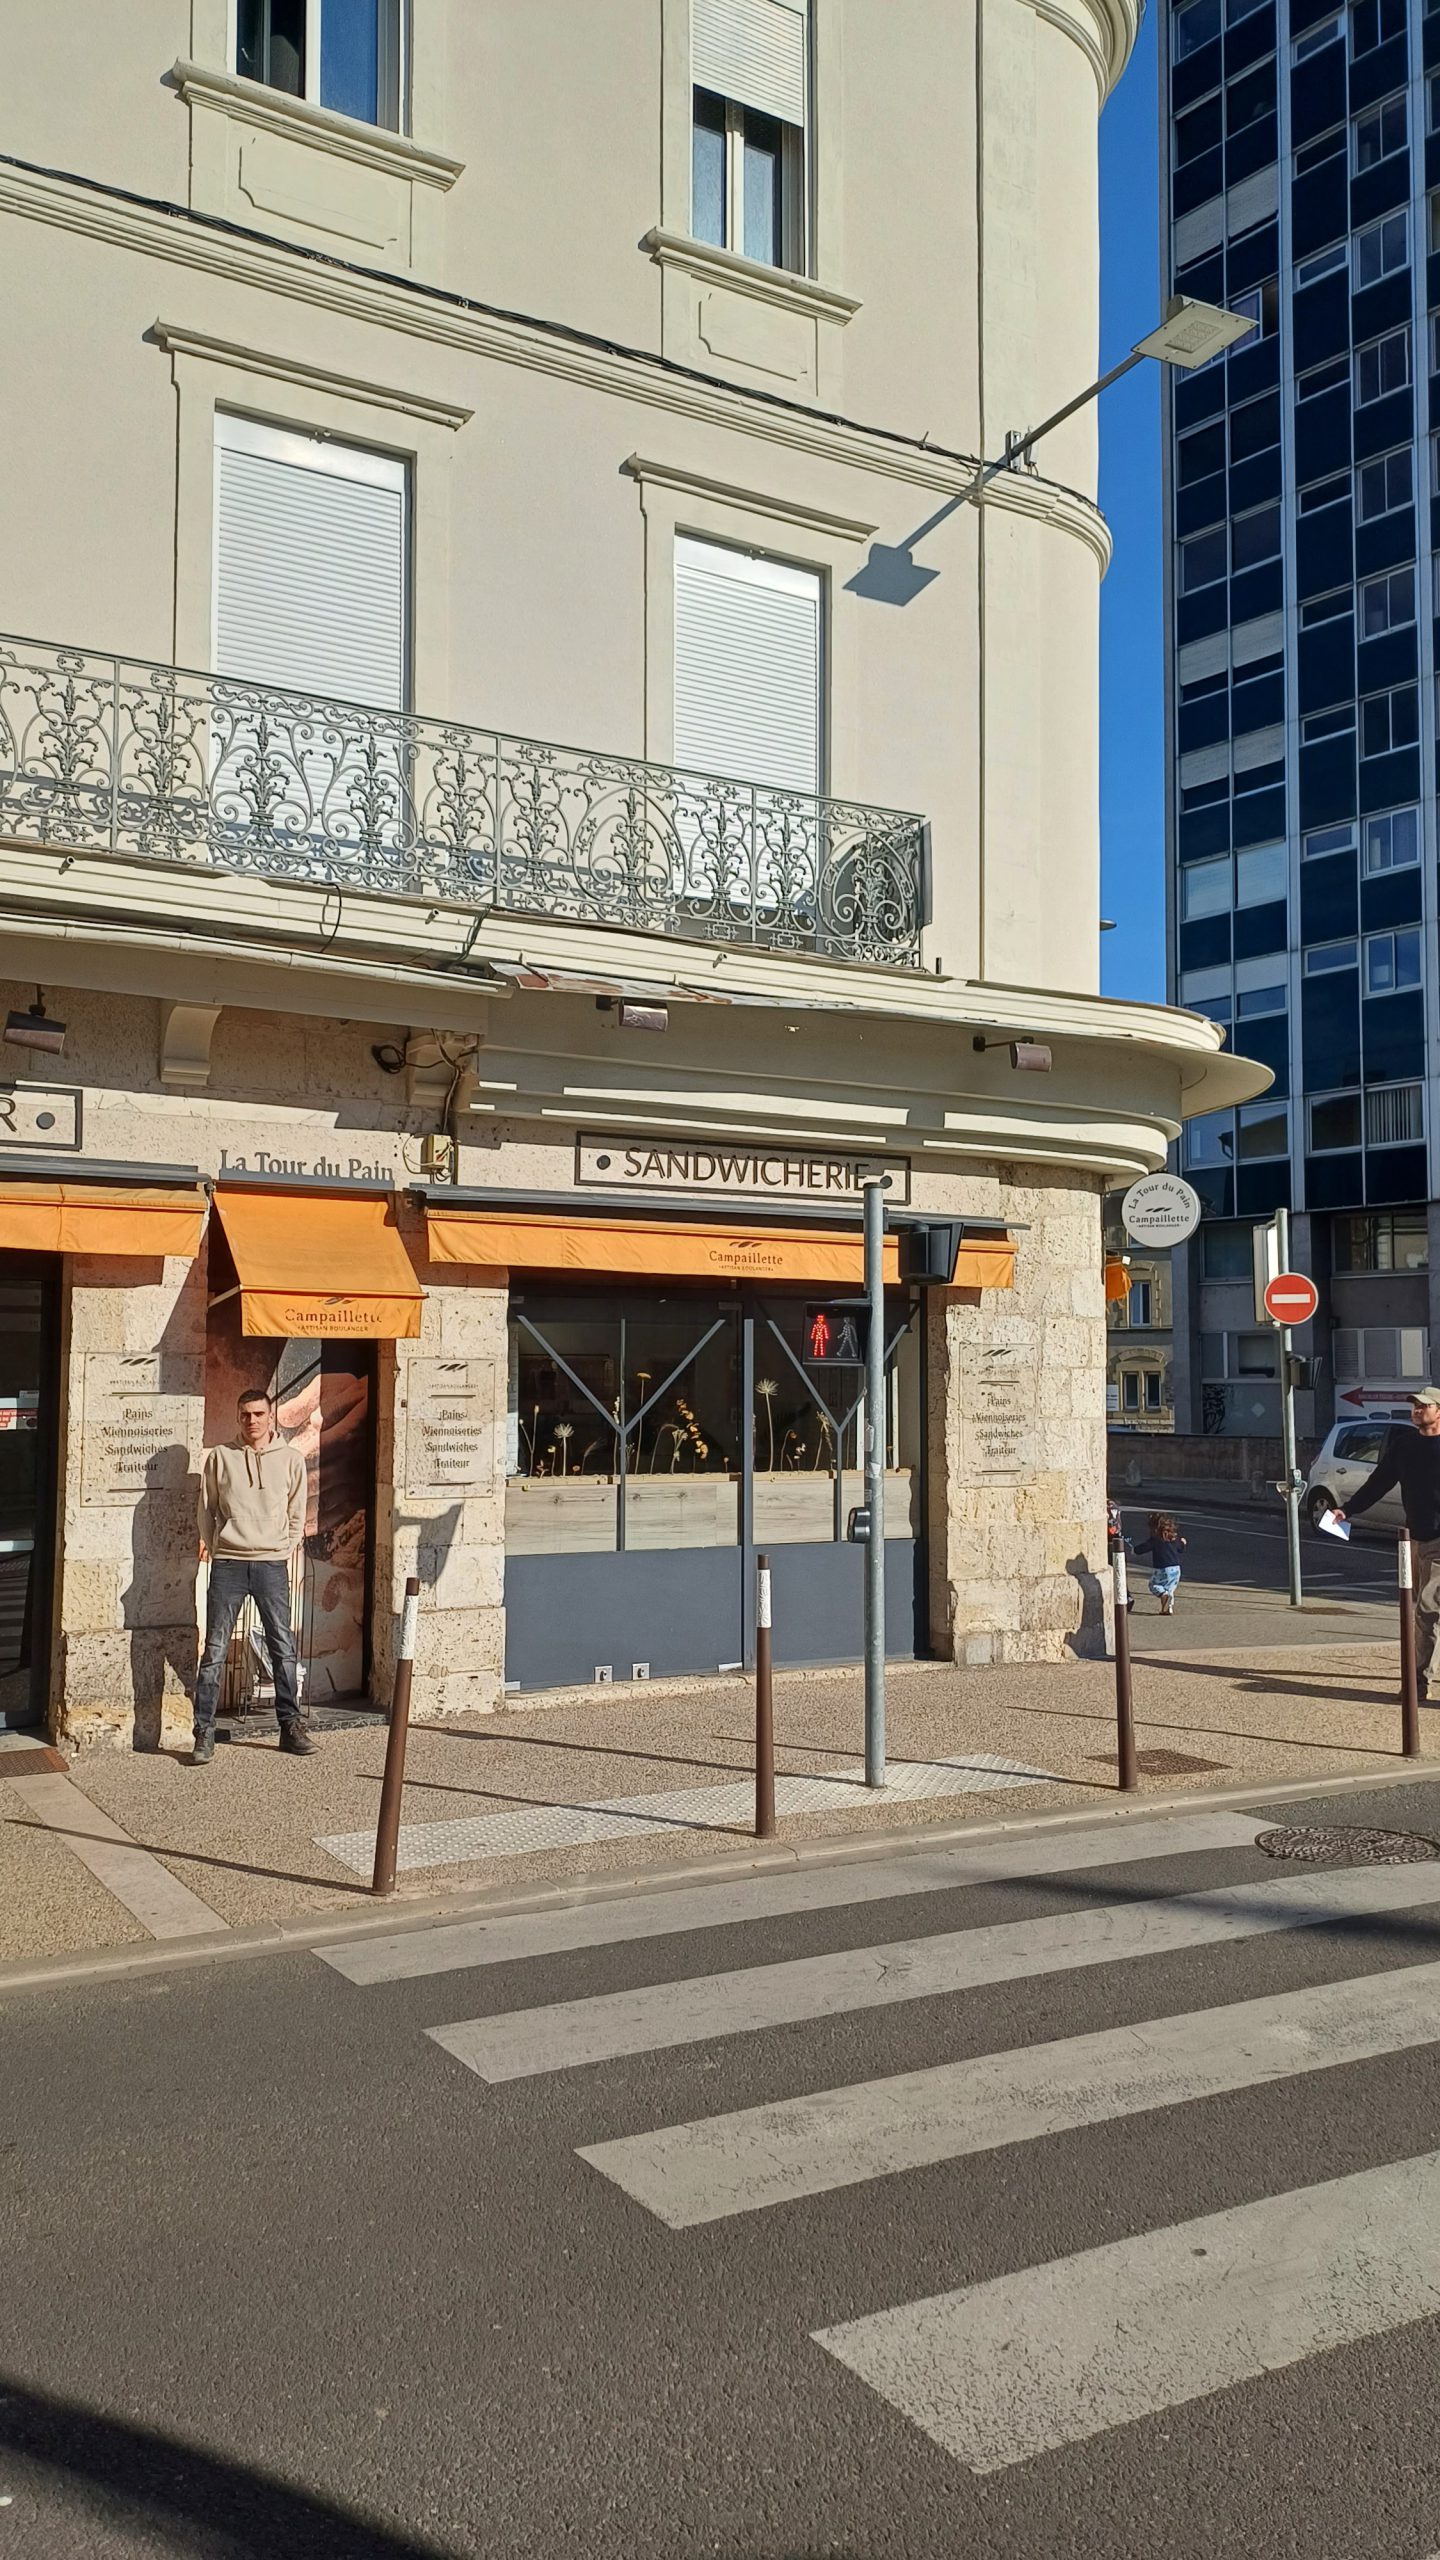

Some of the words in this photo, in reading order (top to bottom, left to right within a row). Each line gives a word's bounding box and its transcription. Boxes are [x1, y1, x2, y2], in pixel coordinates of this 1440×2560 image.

[220, 1149, 247, 1171] La
[254, 1152, 307, 1174] Tour
[313, 1156, 341, 1178] du
[348, 1158, 393, 1181] Pain
[623, 1146, 872, 1191] SANDWICHERIE
[1128, 1198, 1139, 1209] La
[1136, 1184, 1159, 1197] Tour
[1162, 1182, 1174, 1192] du
[1176, 1188, 1191, 1209] Pain
[1128, 1215, 1190, 1224] Campaillette
[709, 1250, 783, 1265] Campaillette
[125, 1408, 153, 1419] Pains
[442, 1409, 465, 1420] Pains
[107, 1443, 168, 1455] Sandwiches
[427, 1442, 478, 1452] Sandwiches
[116, 1461, 158, 1472] Traiteur
[434, 1459, 470, 1468] Traiteur
